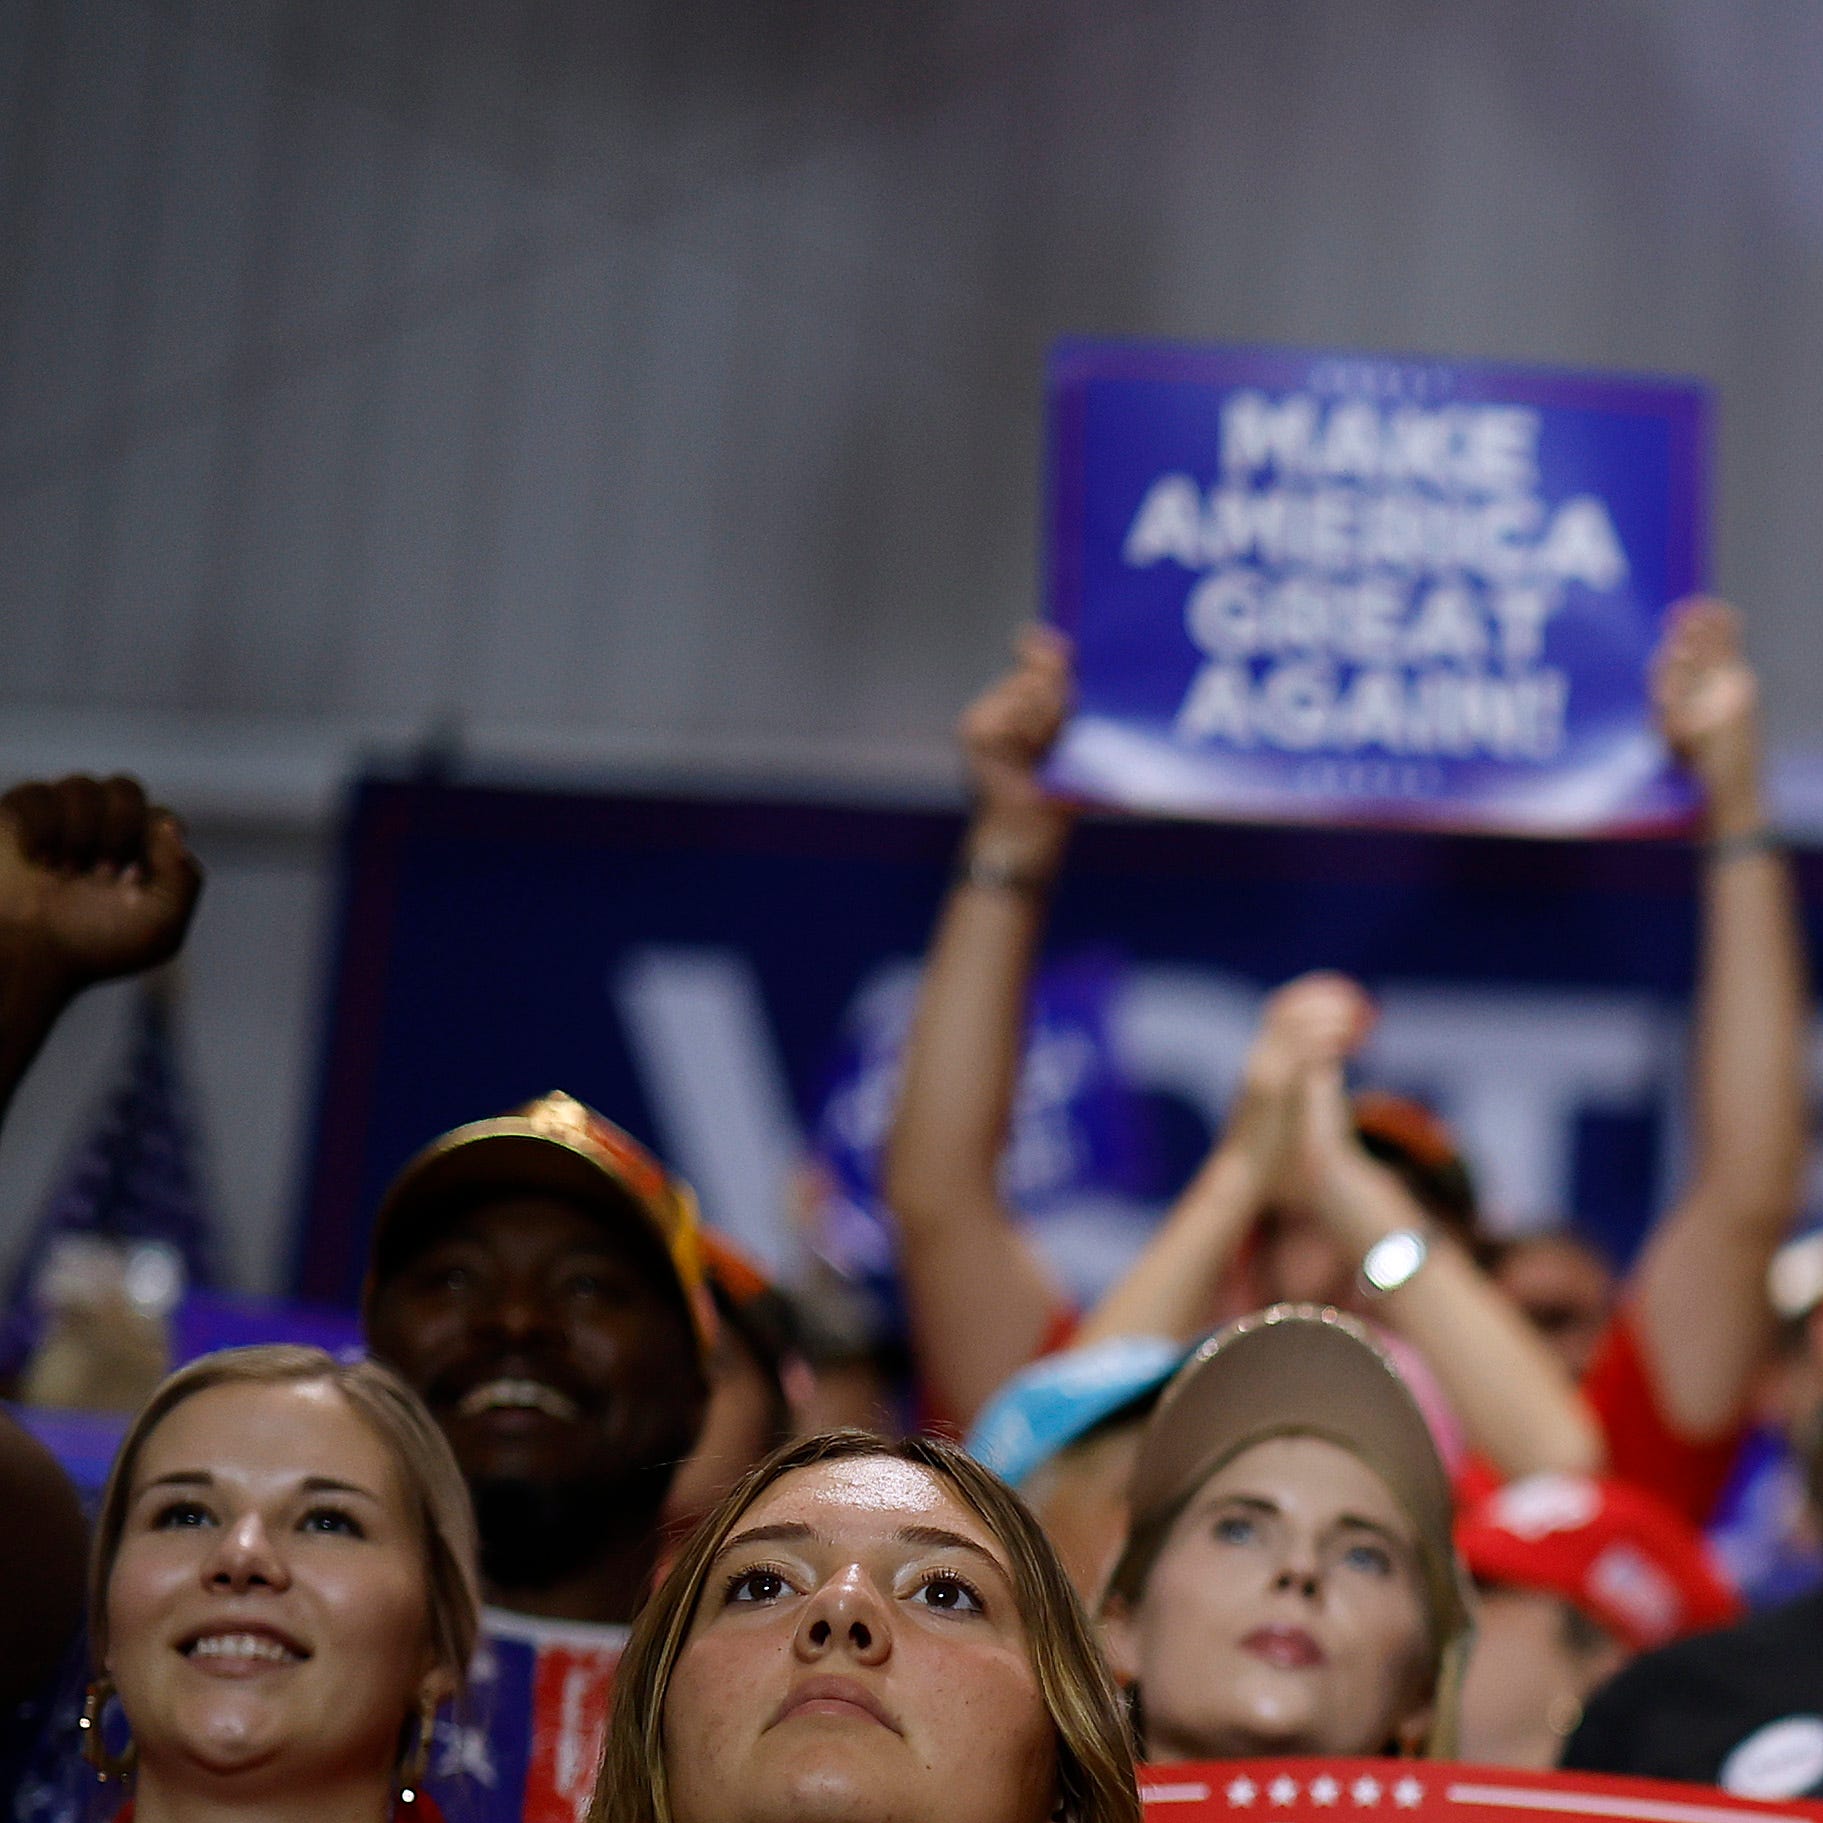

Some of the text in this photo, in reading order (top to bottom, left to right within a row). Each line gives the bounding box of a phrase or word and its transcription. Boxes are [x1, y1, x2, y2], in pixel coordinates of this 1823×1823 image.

[1222, 390, 1538, 492] MAKE
[1125, 475, 1625, 592] AMERICA
[1186, 572, 1552, 684] GREAT
[1178, 660, 1567, 762] AGAIN!
